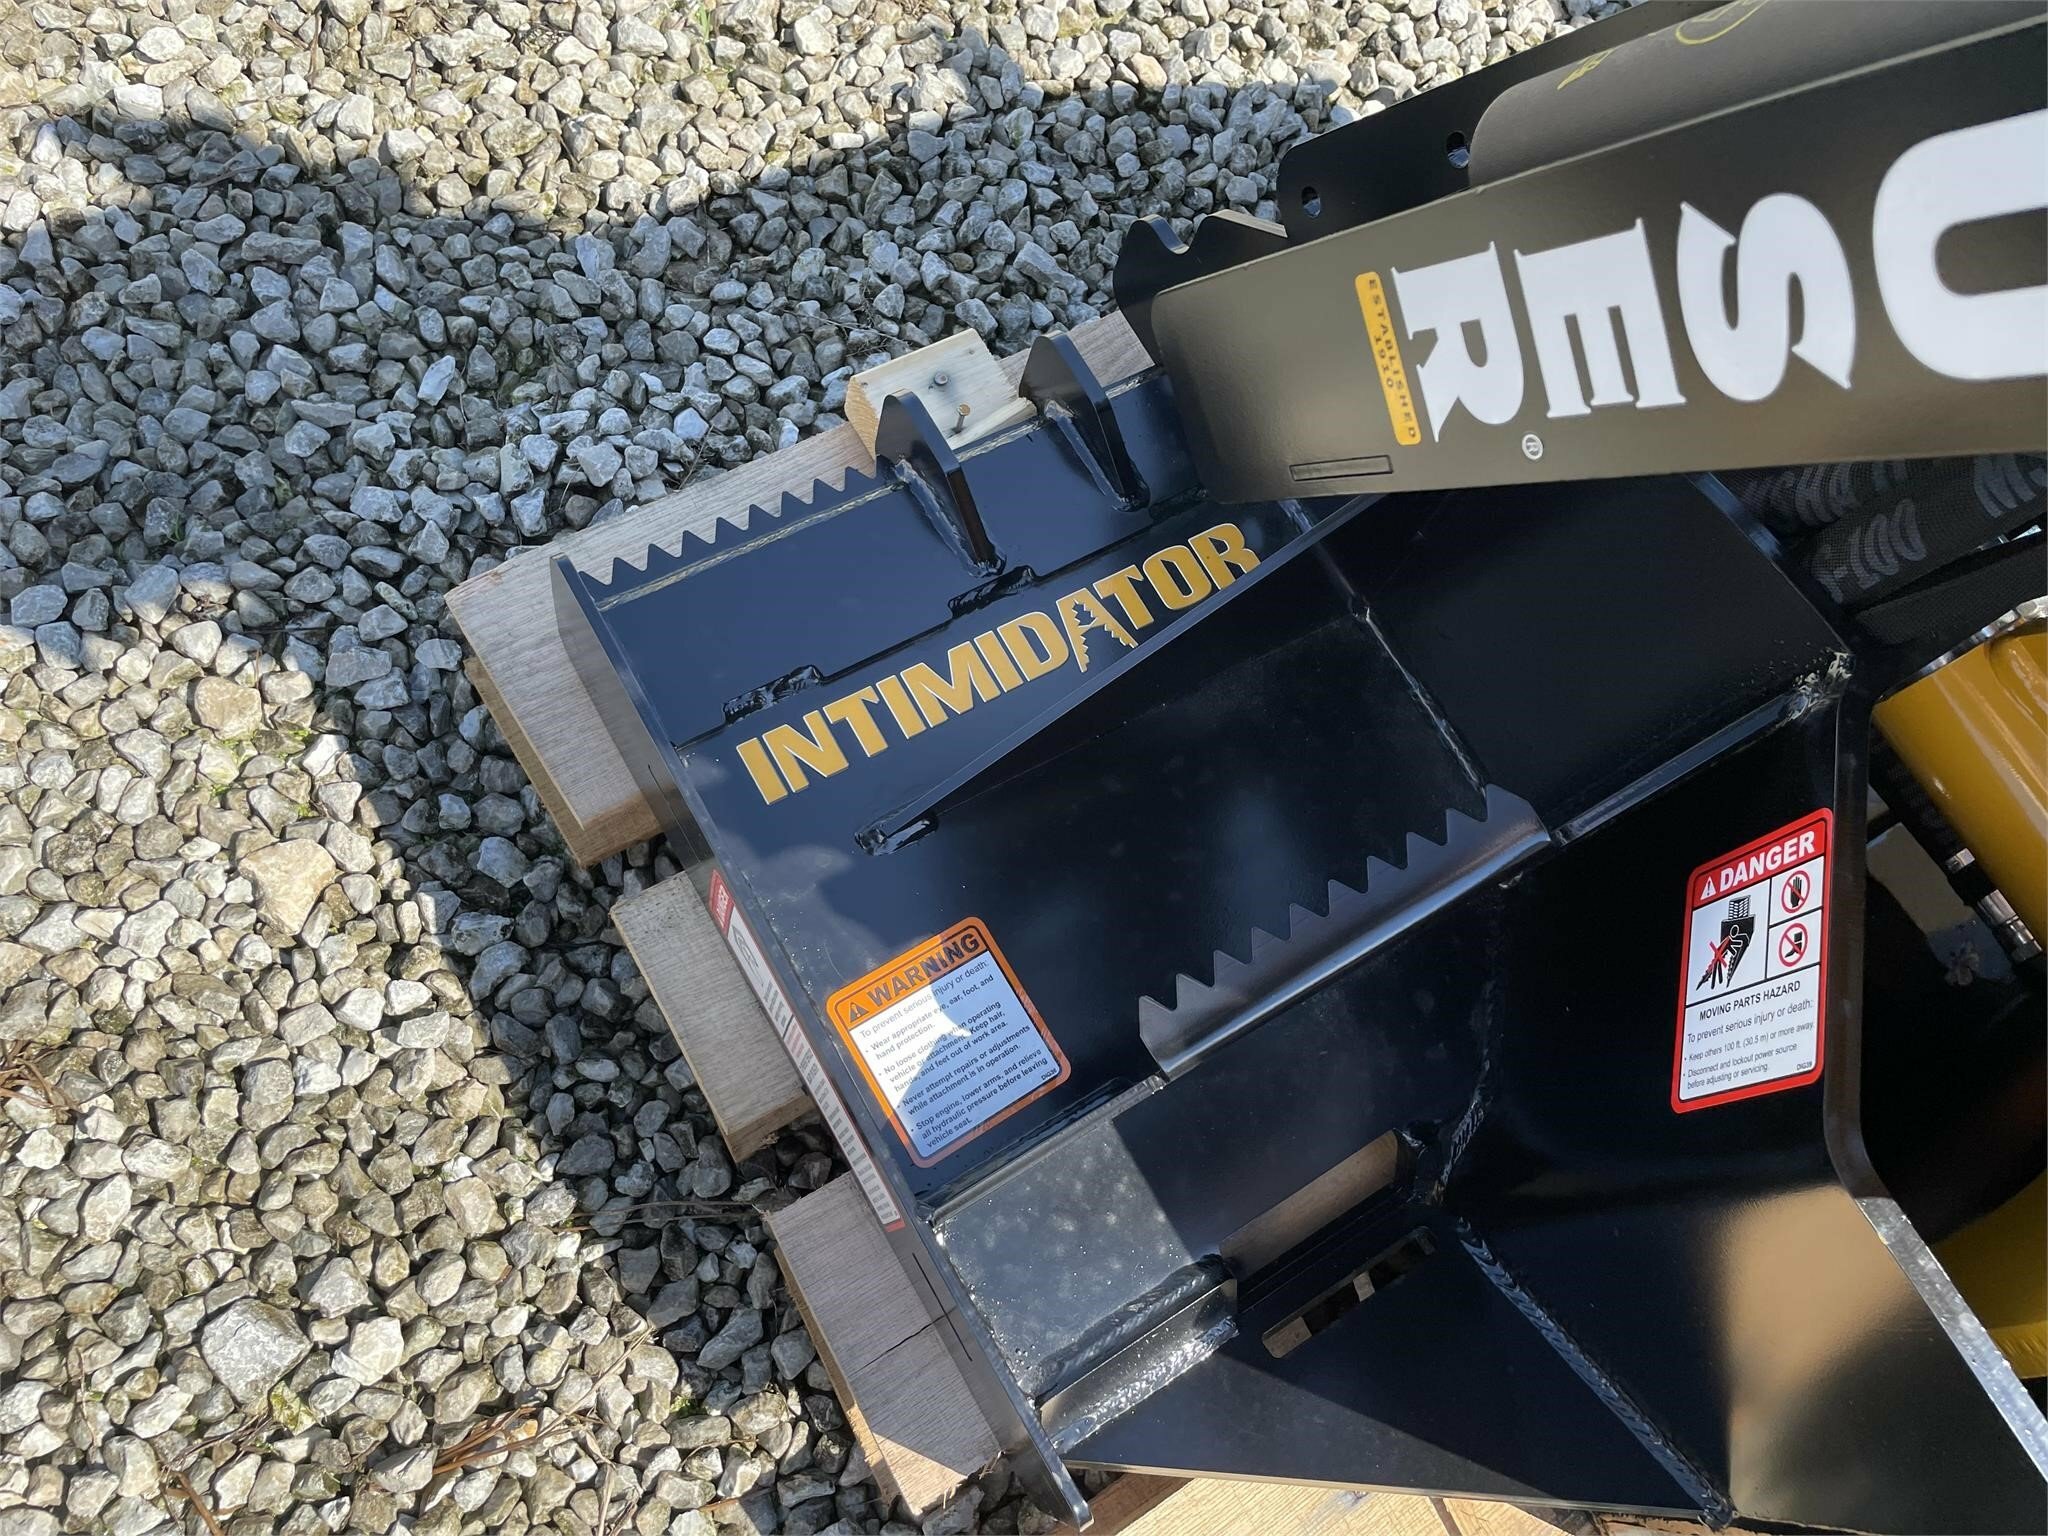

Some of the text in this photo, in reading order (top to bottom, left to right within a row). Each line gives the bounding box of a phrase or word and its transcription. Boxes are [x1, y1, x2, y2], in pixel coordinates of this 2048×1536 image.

[1368, 278, 1417, 438] ESTABLISHED
[1373, 334, 1395, 389] 1910
[735, 522, 1262, 806] INTIMIDATOR
[1719, 830, 1815, 893] DANGER
[859, 959, 987, 1038] To prevent serious injury or death:
[867, 933, 979, 1006] WARNING
[1699, 980, 1800, 1020] MOVING PARTS HAZARD
[870, 1035, 890, 1050] Wear
[891, 1011, 932, 1039] appropriate
[948, 994, 963, 1005] ear,
[962, 984, 980, 996] foot,
[979, 974, 993, 986] and
[875, 1023, 935, 1060] hand protection.
[883, 1064, 895, 1073] No
[895, 1051, 916, 1067] loose
[917, 1033, 948, 1054] clothing
[967, 1001, 1001, 1024] operating
[1687, 999, 1812, 1043] To prevent serious injury or death:
[1688, 1052, 1703, 1060] Keep
[1704, 1046, 1722, 1057] others
[1724, 1040, 1735, 1052] 100
[1769, 1031, 1776, 1039] or
[1777, 1026, 1794, 1036] more
[889, 1064, 916, 1082] vehicle
[968, 1020, 988, 1034] Keep
[987, 1010, 1005, 1022] hair,
[901, 1025, 1030, 1106] Never attempt repairs or adjustments
[920, 1063, 935, 1076] and
[934, 1054, 950, 1067] feet
[949, 1046, 963, 1058] out
[963, 1040, 971, 1050] of
[971, 1031, 990, 1044] work
[990, 1021, 1006, 1034] area.
[1687, 1062, 1718, 1077] Disconnect
[1719, 1059, 1731, 1069] and
[1754, 1049, 1774, 1062] power
[1775, 1043, 1797, 1055] source
[907, 1099, 928, 1115] while
[928, 1074, 969, 1102] attachment
[967, 1070, 976, 1078] is
[975, 1064, 985, 1072] in
[915, 1048, 1041, 1130] Stop engine, lower arms, and relieve
[921, 1057, 1047, 1139] all hydraulic pressure before leaving
[1687, 1079, 1705, 1089] before
[1705, 1072, 1732, 1085] adjusting
[1732, 1070, 1739, 1078] or
[926, 1117, 972, 1147] vehicle seat.
